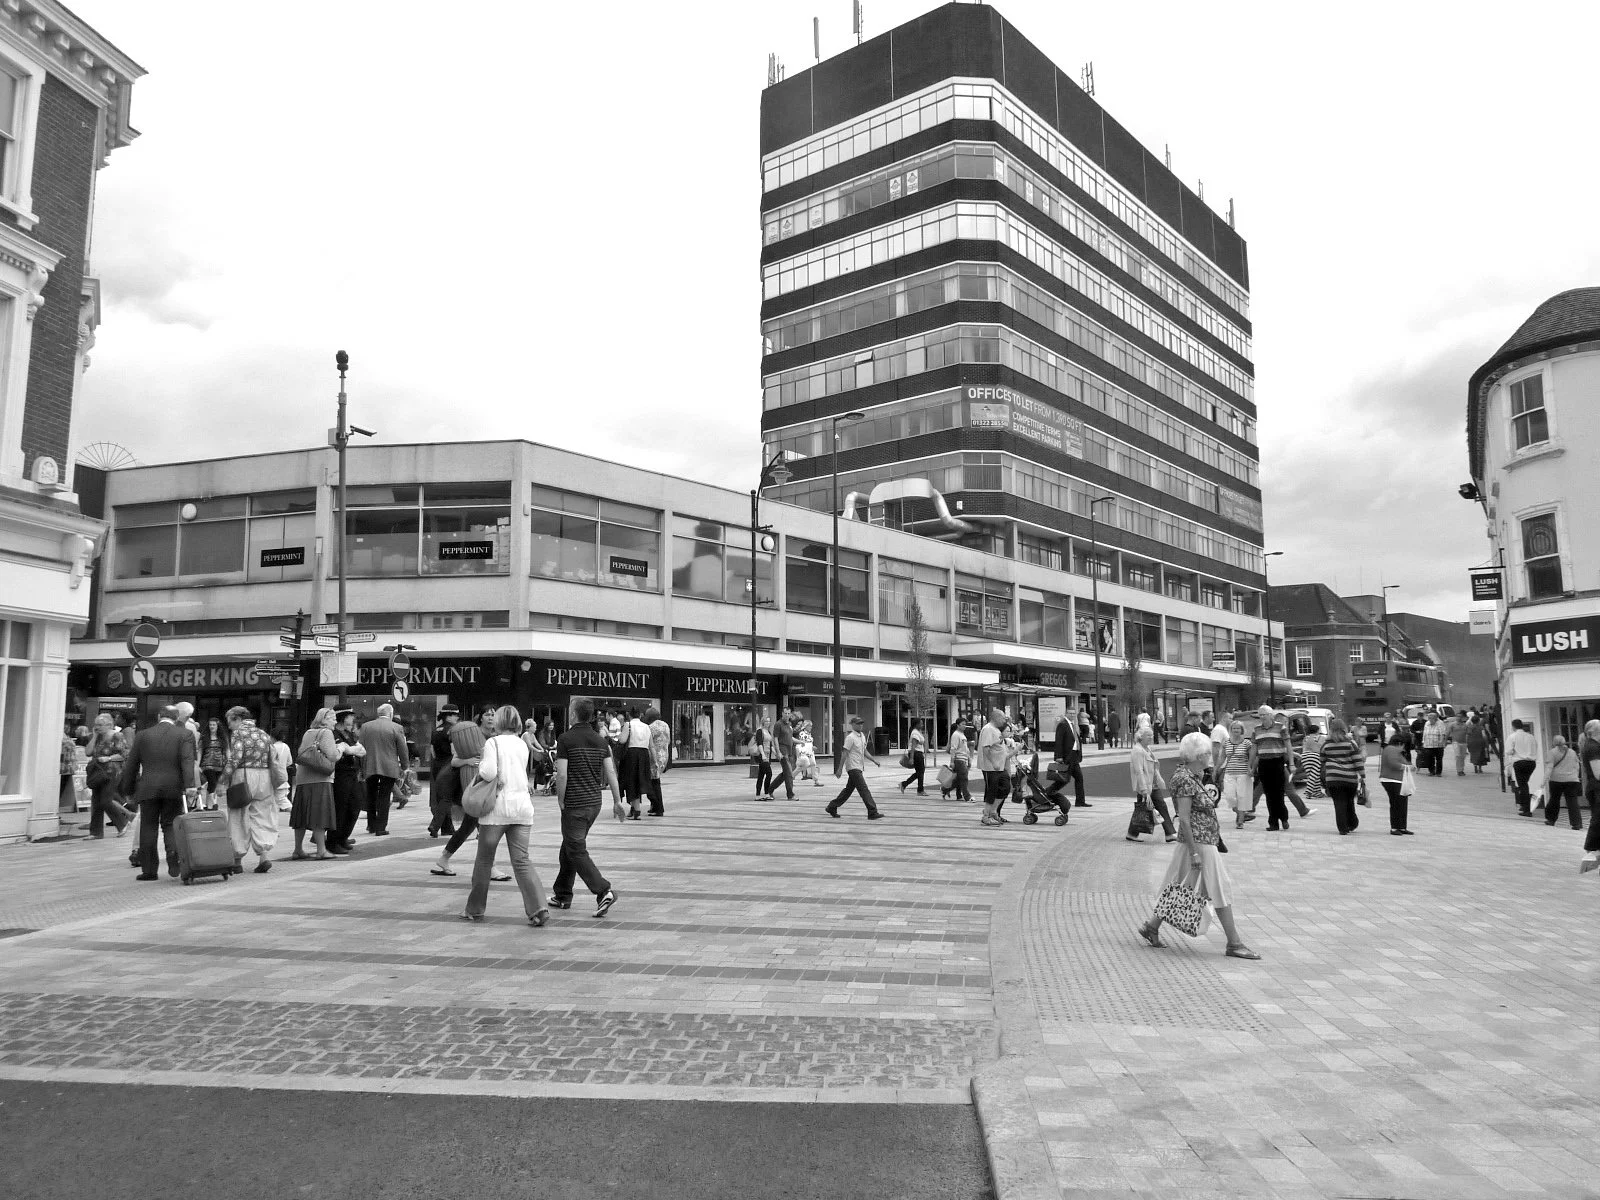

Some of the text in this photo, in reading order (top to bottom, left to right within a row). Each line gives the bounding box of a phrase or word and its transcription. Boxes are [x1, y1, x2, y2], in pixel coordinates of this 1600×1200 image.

[968, 387, 1012, 402] OFFICES
[1012, 393, 1021, 406] TO
[1022, 397, 1034, 412] LET
[1034, 403, 1051, 418] FROM
[1012, 411, 1061, 438] COMPETITIVE TERMS
[1012, 422, 1041, 441] EXCELLENT
[1041, 432, 1062, 449] PARKING
[263, 552, 303, 562] PEPPERMINT
[441, 546, 490, 554] PEPPERMINT
[612, 561, 647, 573] PEPPERMINT
[1521, 629, 1589, 654] LUSH
[145, 668, 206, 688] RGER
[210, 667, 259, 686] KING
[357, 666, 480, 684] EPPRMINT
[547, 668, 650, 689] PEPPERMINT
[1040, 672, 1068, 687] GREGGS
